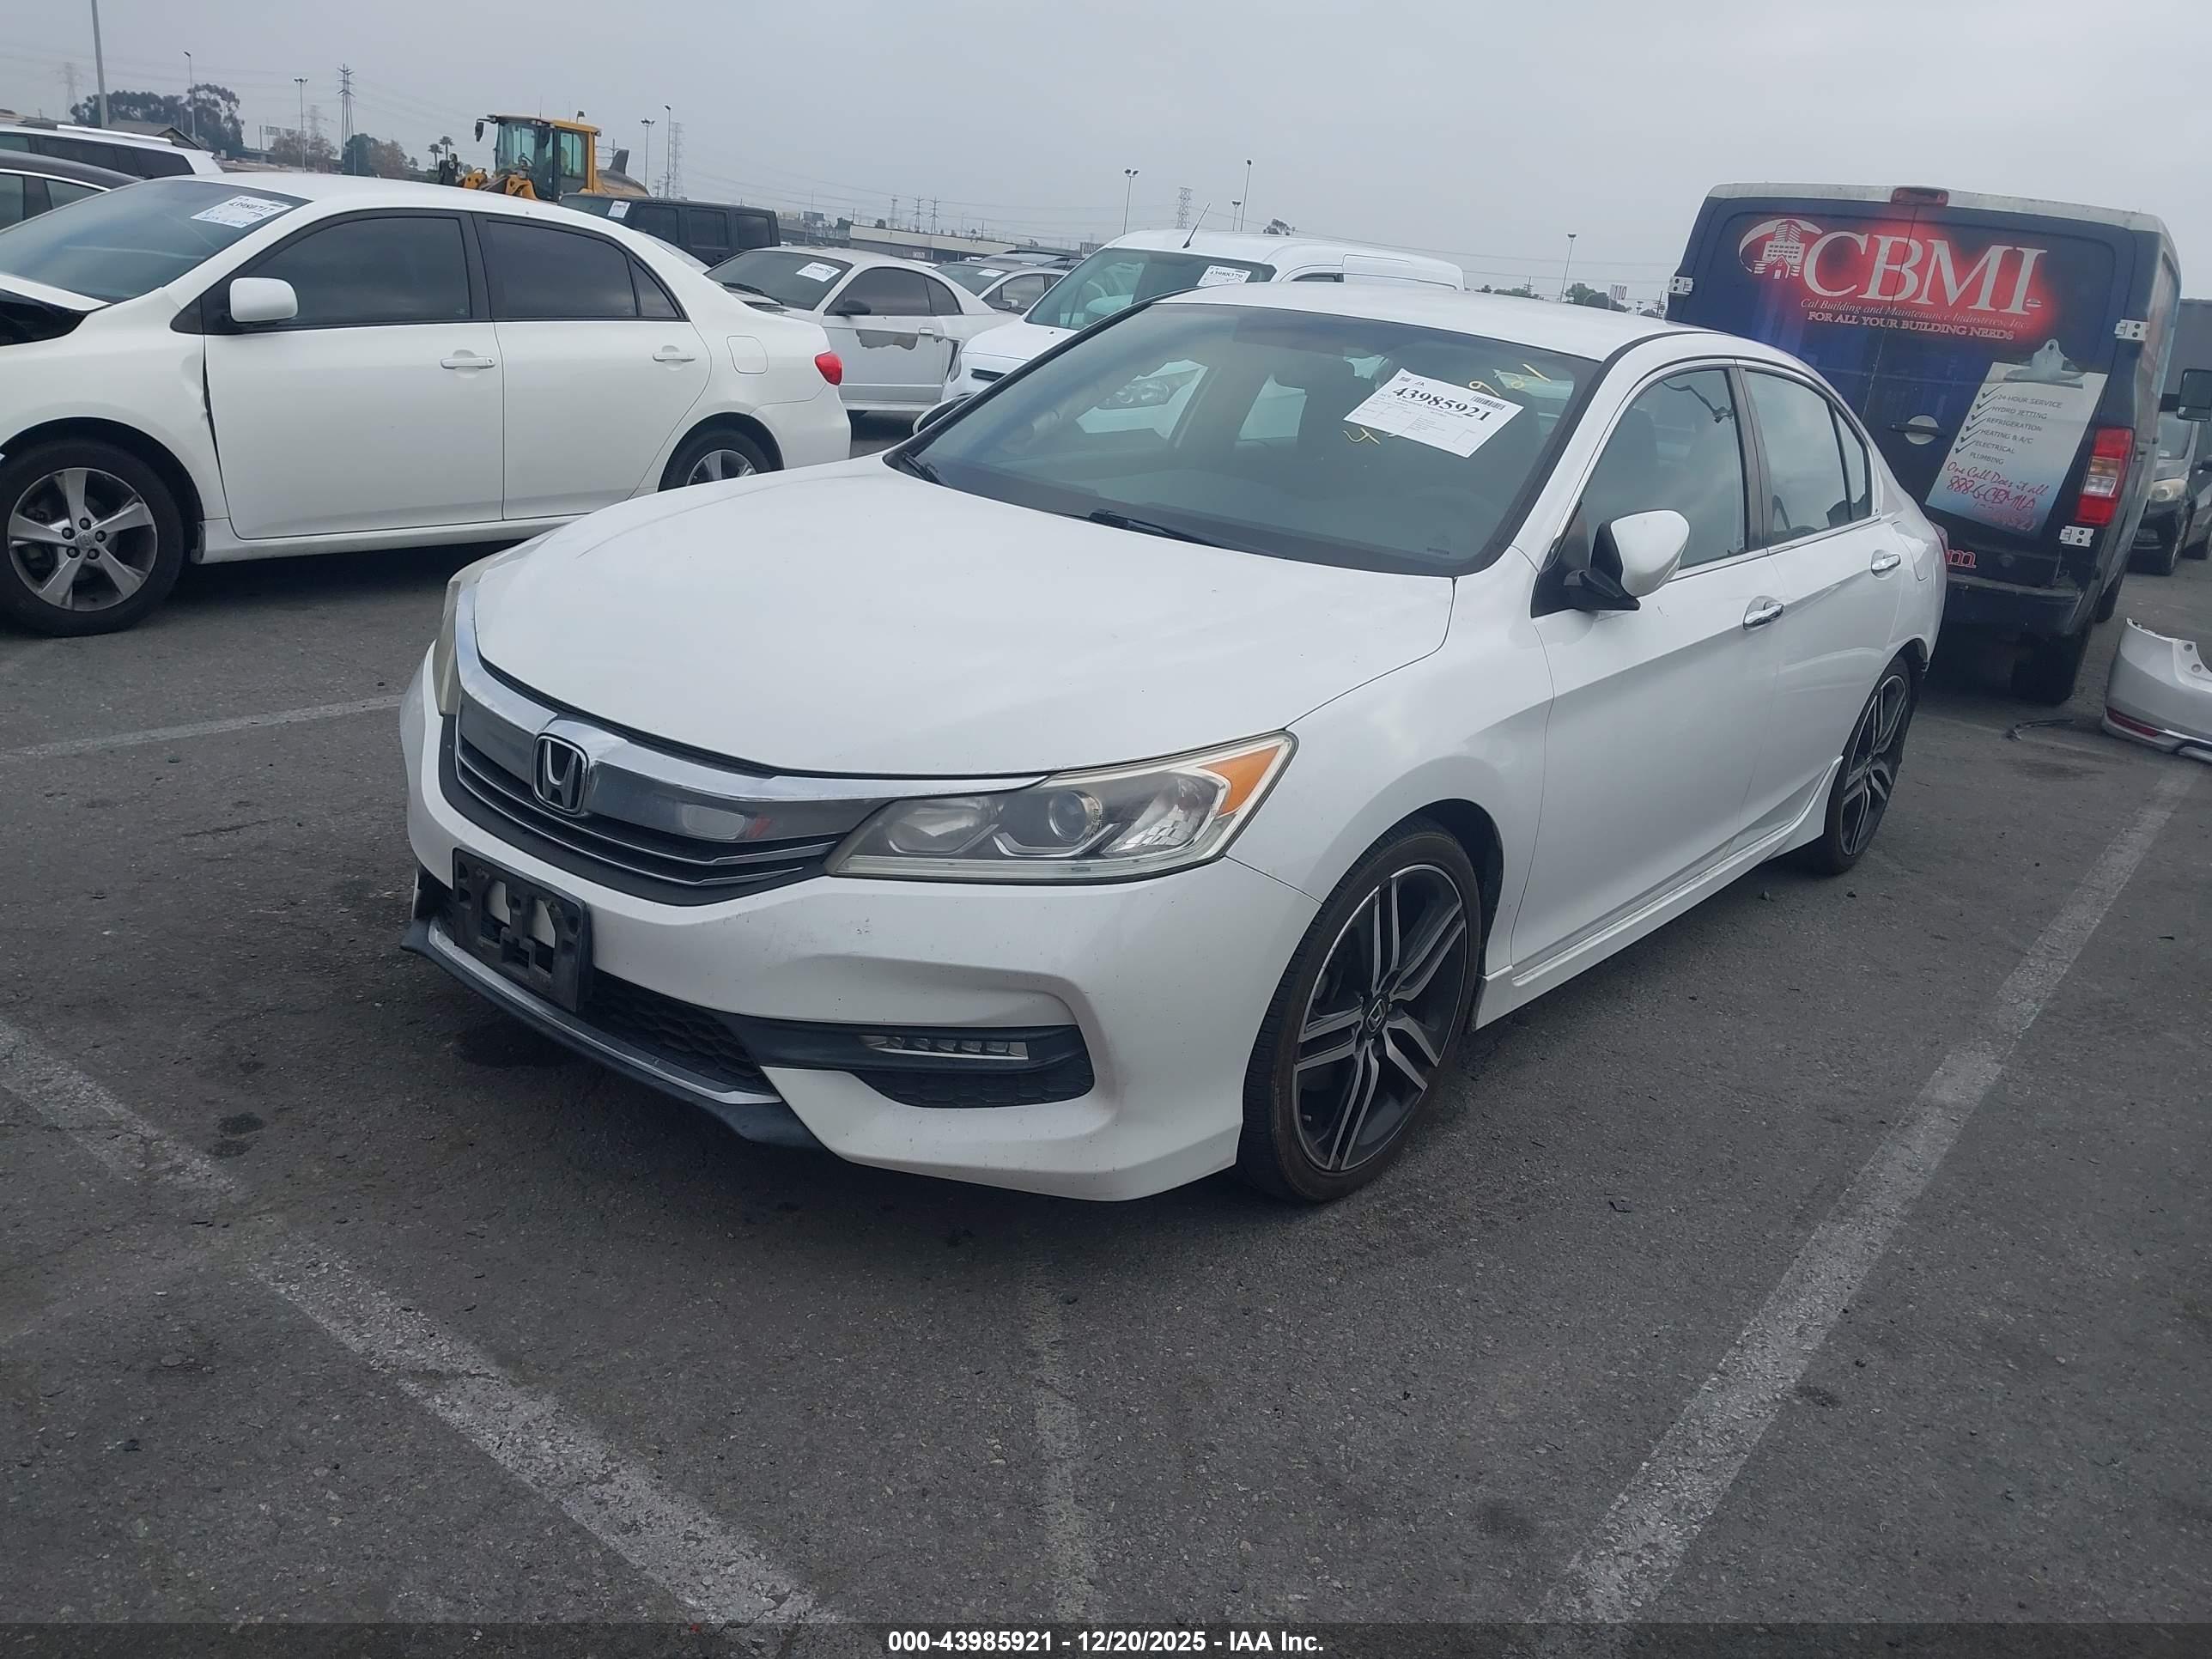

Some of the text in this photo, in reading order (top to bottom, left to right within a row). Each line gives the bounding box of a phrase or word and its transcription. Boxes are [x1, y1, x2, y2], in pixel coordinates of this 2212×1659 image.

[1803, 231, 2048, 315] CBMI
[1801, 298, 1819, 309] Cal
[1820, 300, 1861, 314] Building
[1863, 305, 1885, 314] and
[1808, 311, 2015, 340] FOR ALL YOUR BUILDING NEEDS
[1392, 387, 1492, 422] 43985921
[2030, 398, 2063, 409] SERVICE
[1992, 405, 2048, 420] HYDRO JETTING
[1985, 417, 2043, 432] REFRIGERATION
[1980, 428, 2010, 440] HEATING
[1975, 440, 2016, 454] ELECTRICAL
[1970, 451, 2005, 465] PLUMBING
[1946, 461, 1966, 474] One
[1966, 466, 1992, 481] Call
[2027, 483, 2050, 496] all
